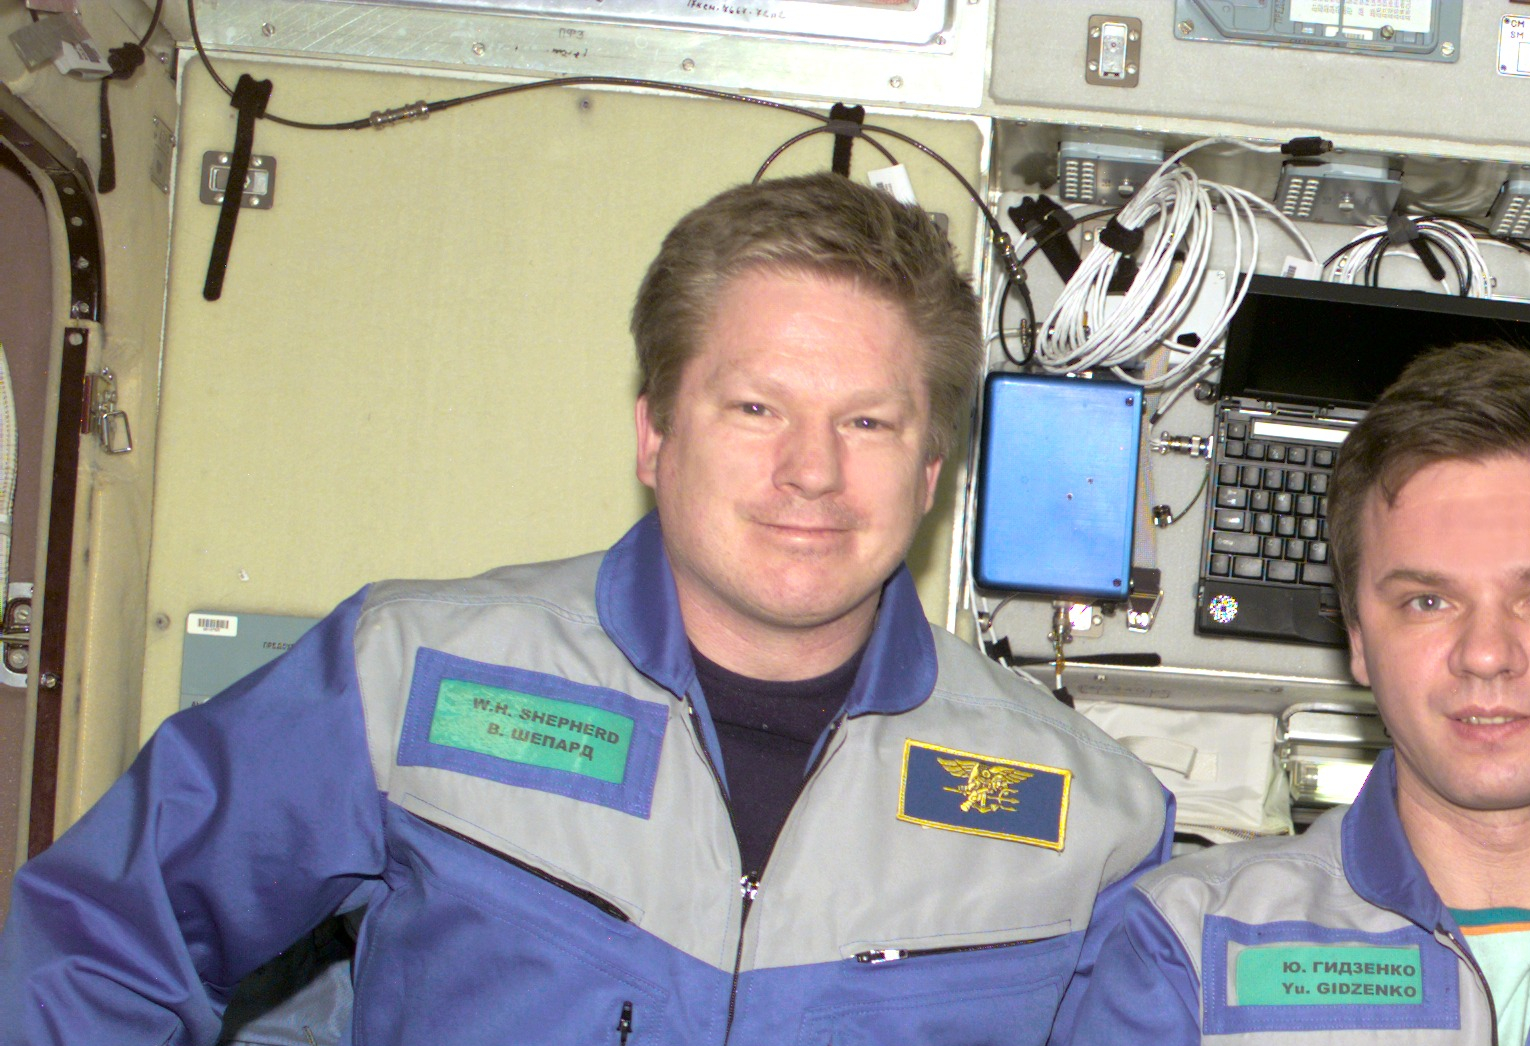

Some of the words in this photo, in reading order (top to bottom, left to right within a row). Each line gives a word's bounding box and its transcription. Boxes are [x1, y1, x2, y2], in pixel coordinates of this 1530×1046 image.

[473, 697, 512, 717] W.H.
[519, 708, 620, 745] SHEPHERD
[487, 722, 504, 737] В.
[511, 727, 595, 761] ШЕПАРД
[1282, 961, 1306, 973] Ю.
[1312, 961, 1416, 977] ГИДЗЕНКО
[1282, 982, 1310, 995] Yu.
[1316, 982, 1417, 998] GIDZENKO
